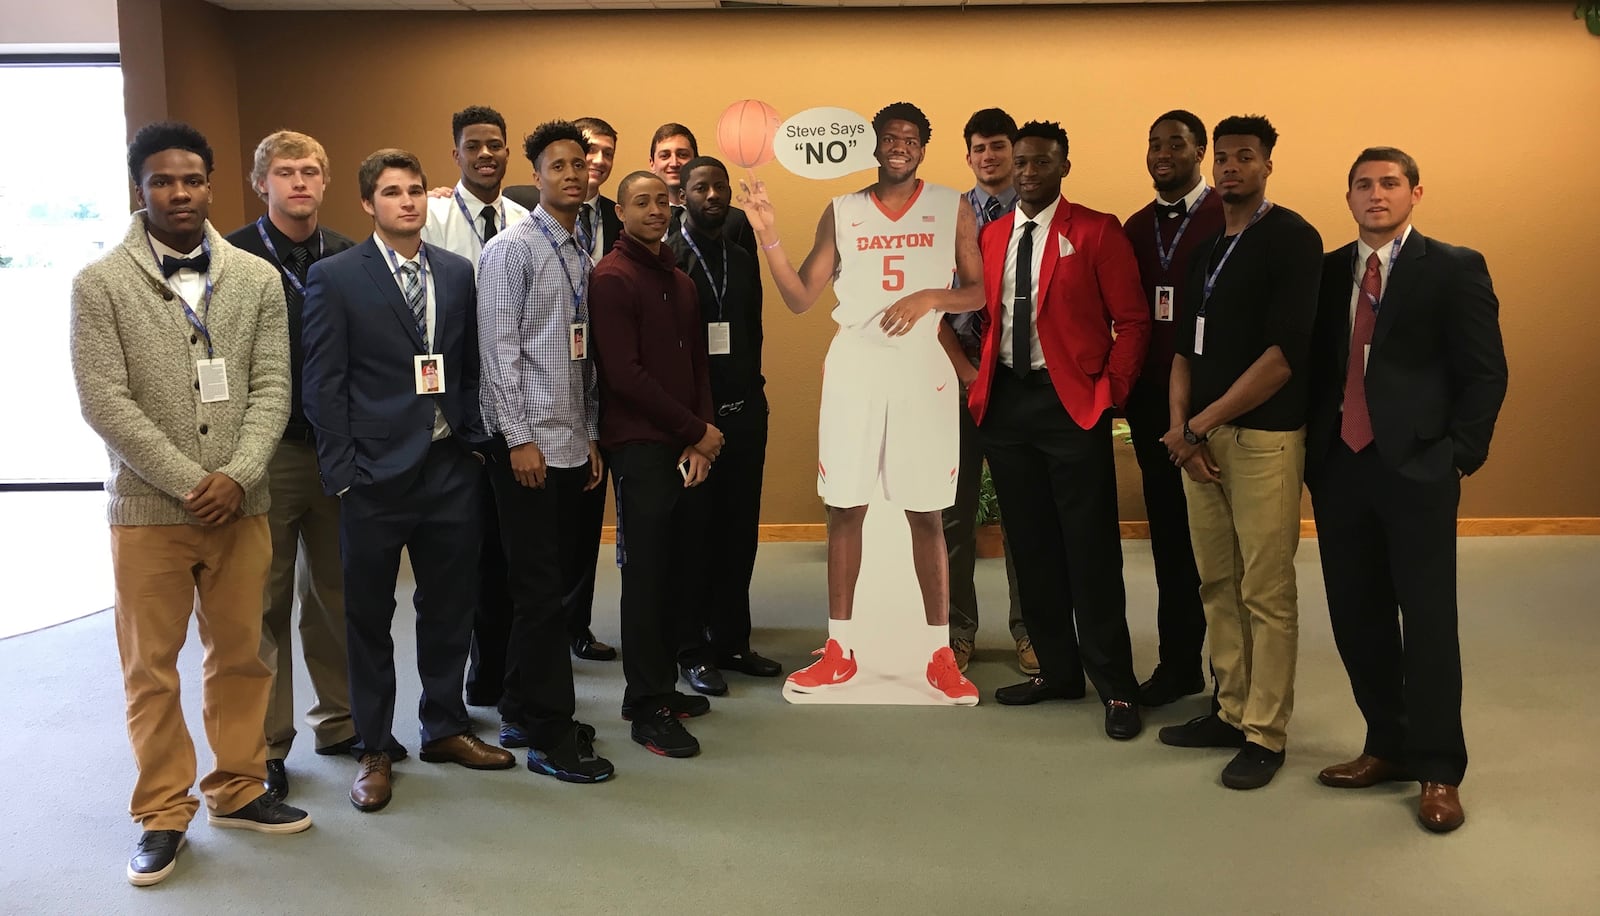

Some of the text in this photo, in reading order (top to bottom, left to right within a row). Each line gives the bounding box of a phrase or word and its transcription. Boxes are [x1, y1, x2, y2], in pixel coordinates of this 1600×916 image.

[786, 122, 865, 138] Steve Says
[856, 233, 935, 251] DAYTON
[882, 255, 904, 291] 5
